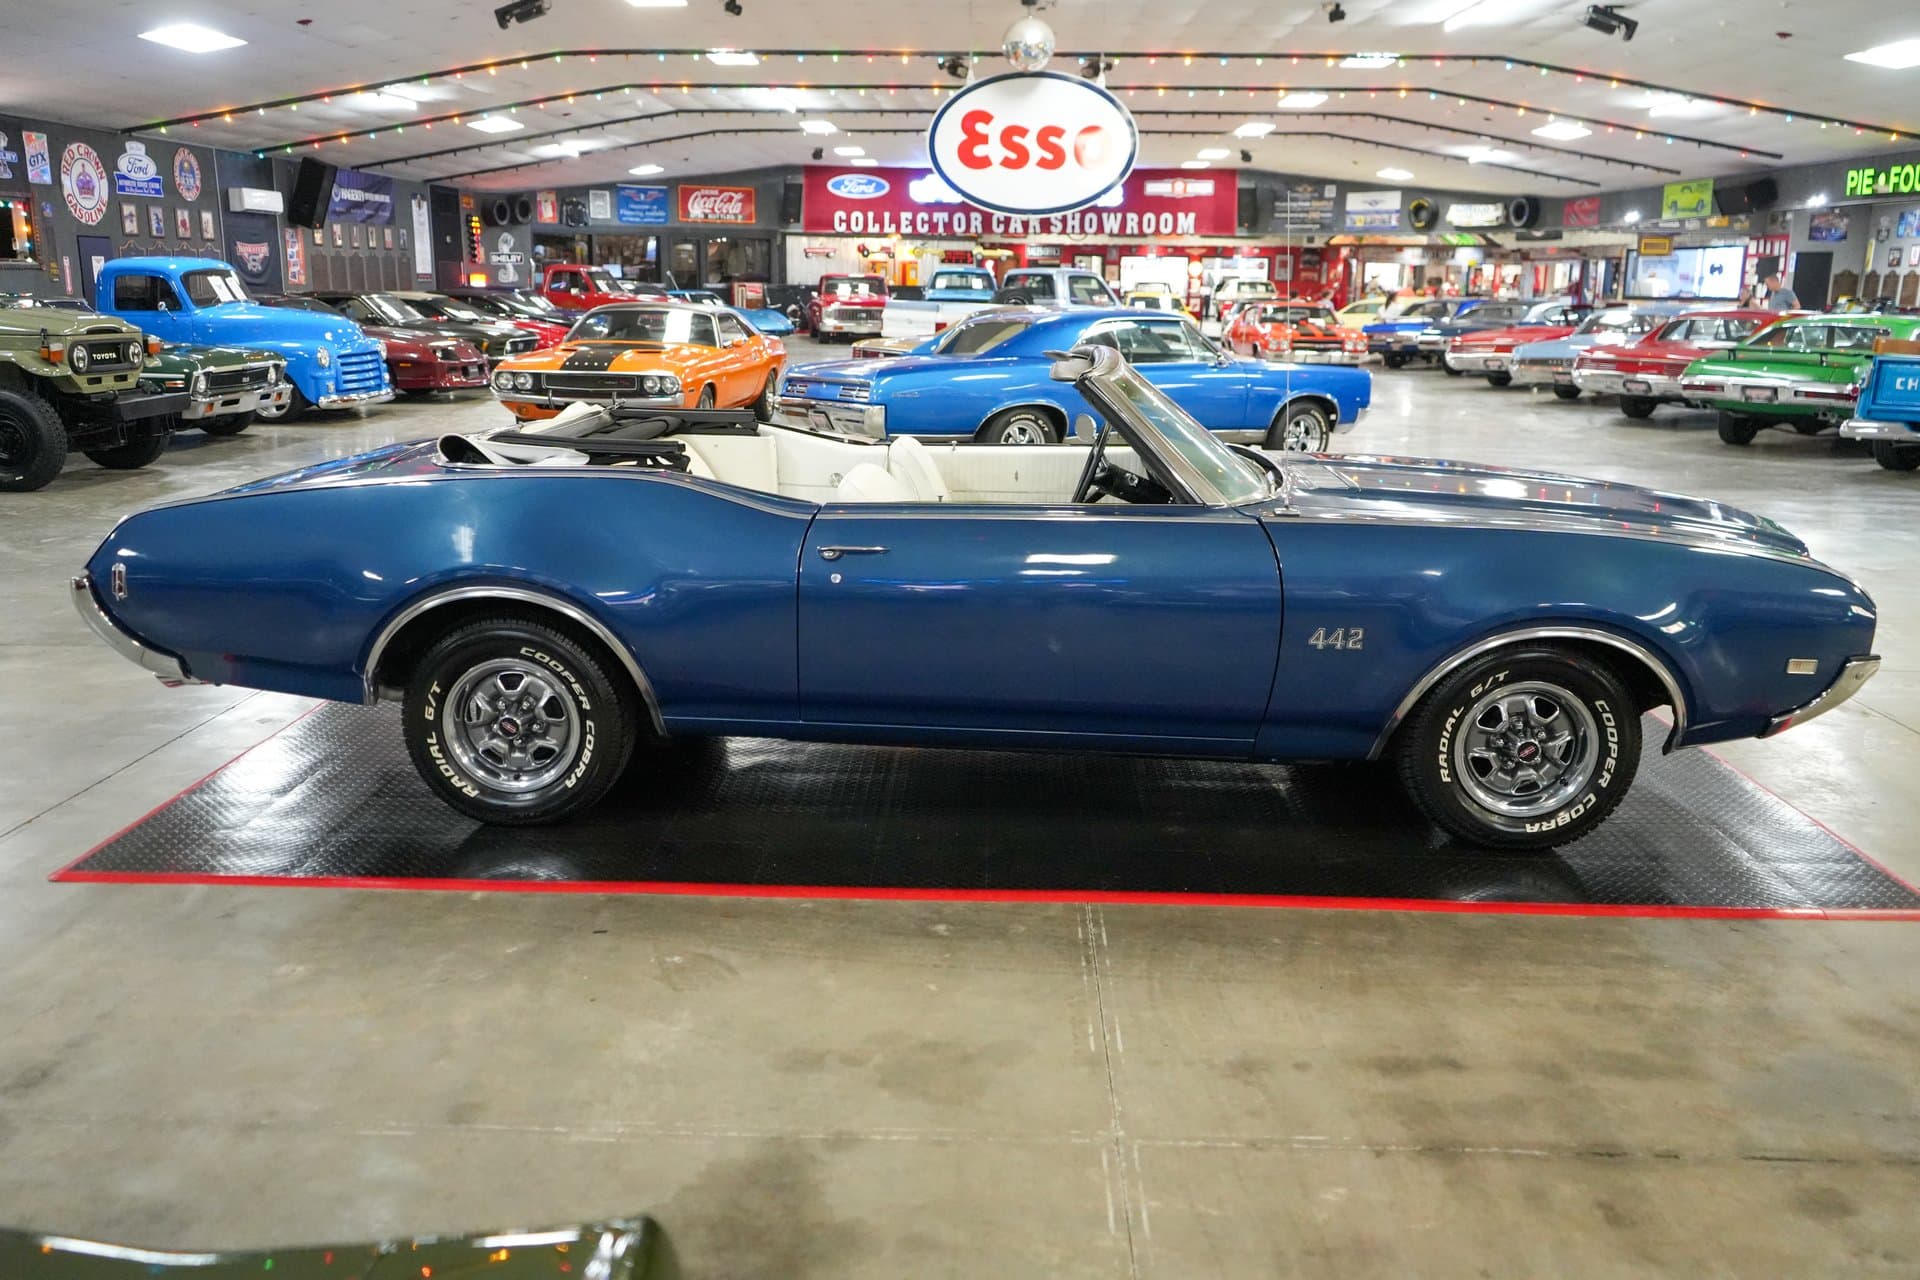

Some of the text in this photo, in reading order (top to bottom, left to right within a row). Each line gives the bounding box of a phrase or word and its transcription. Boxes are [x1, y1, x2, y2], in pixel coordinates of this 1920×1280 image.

[62, 144, 106, 180] RED CROWN
[126, 157, 149, 176] Ford
[840, 178, 877, 194] Ford
[1845, 168, 1875, 196] PIE
[66, 193, 107, 223] GASOLINE
[833, 210, 1197, 235] COLLECTOR CAR SHOWROOM
[92, 352, 117, 360] TOYOTA
[1308, 627, 1364, 650] 442
[519, 647, 596, 789] COOPER COBRA
[1438, 670, 1510, 783] RADIAL G/T
[424, 680, 480, 798] RADIAL G/T
[1525, 699, 1619, 833] COOPER COBRA
